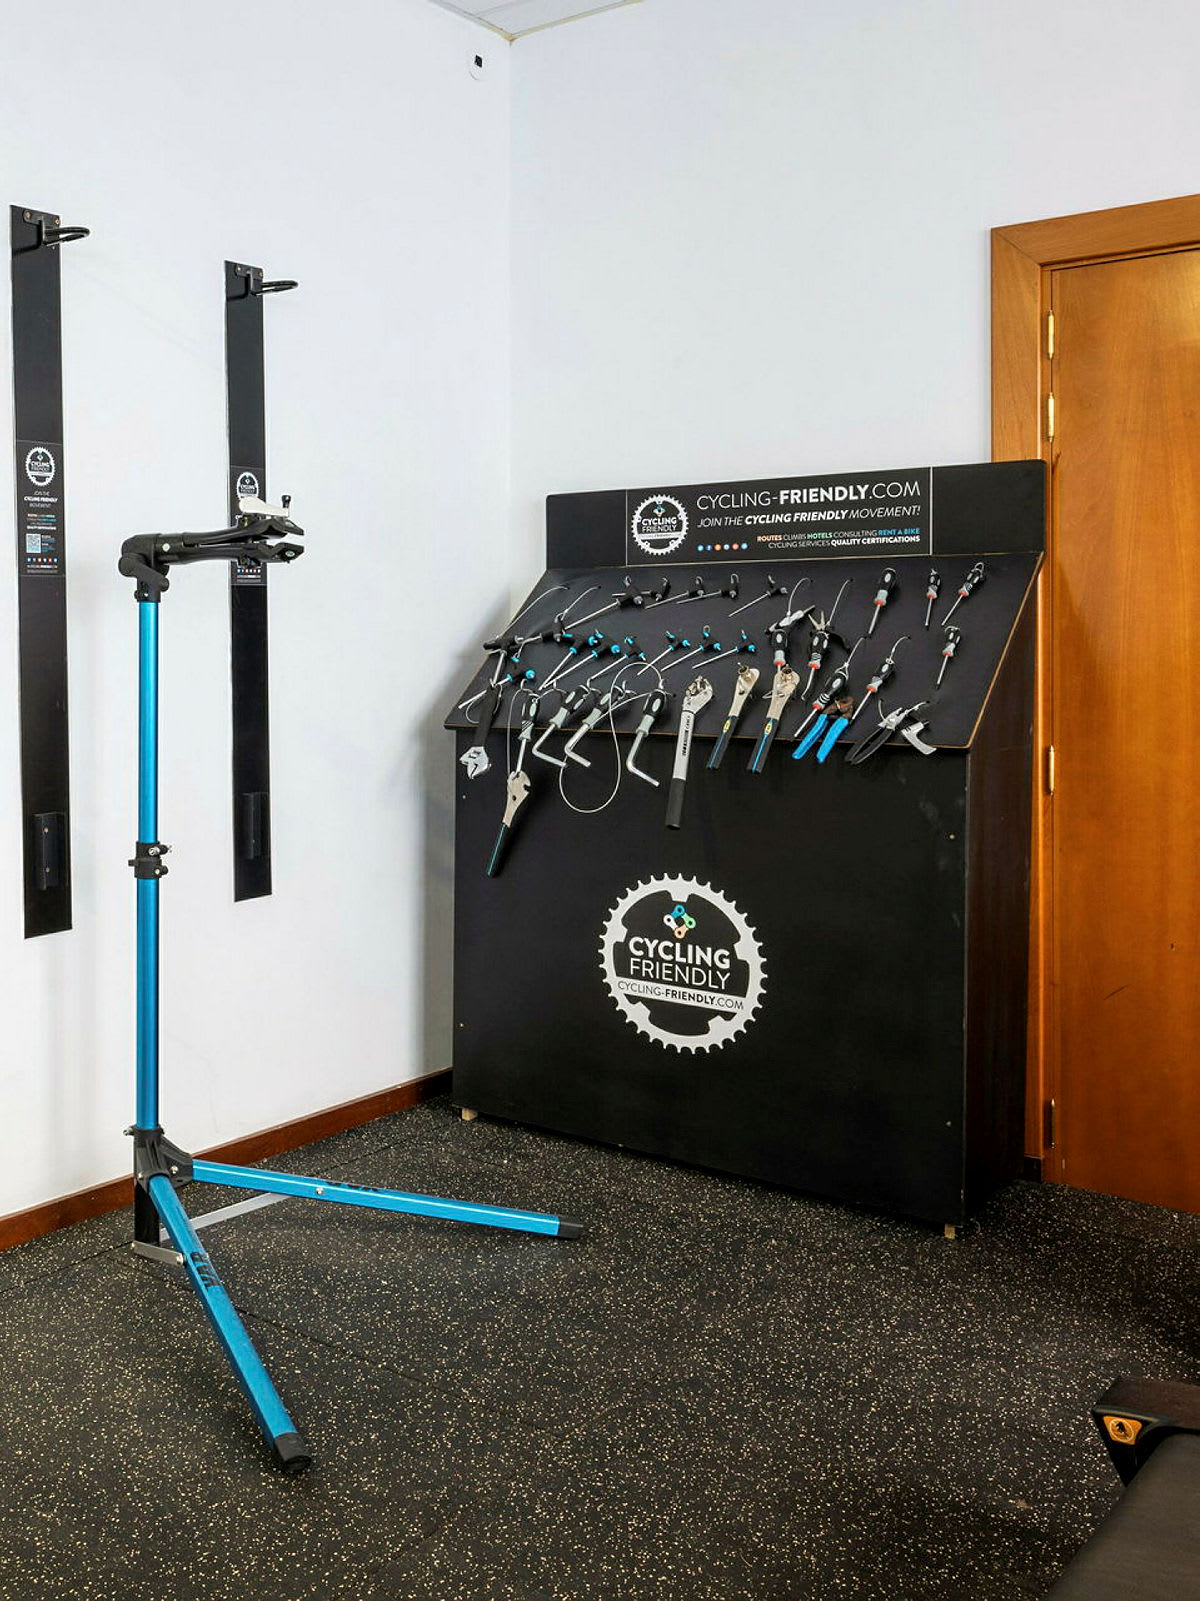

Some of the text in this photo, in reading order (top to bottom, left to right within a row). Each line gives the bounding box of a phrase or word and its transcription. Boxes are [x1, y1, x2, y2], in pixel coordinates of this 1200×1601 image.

[696, 480, 921, 510] CYCLING-FRIENDLY.COM
[641, 516, 677, 526] CYCLING
[697, 504, 921, 528] JOIN THE CYCLING FRIENDLY MOVEMENT!
[641, 524, 677, 533] FRIENDLY
[757, 534, 782, 542] ROUTES
[782, 533, 807, 541] CLIMBS
[807, 532, 832, 540] HOTELS
[833, 529, 877, 538] CONSULTING
[768, 535, 921, 549] CYCLING SERVICES QUALITY CERTIFICATIONS
[628, 936, 731, 969] CYCLING
[629, 957, 731, 990] FRIENDLY
[617, 980, 744, 1010] CYCLING-FRIENDLY.COM
